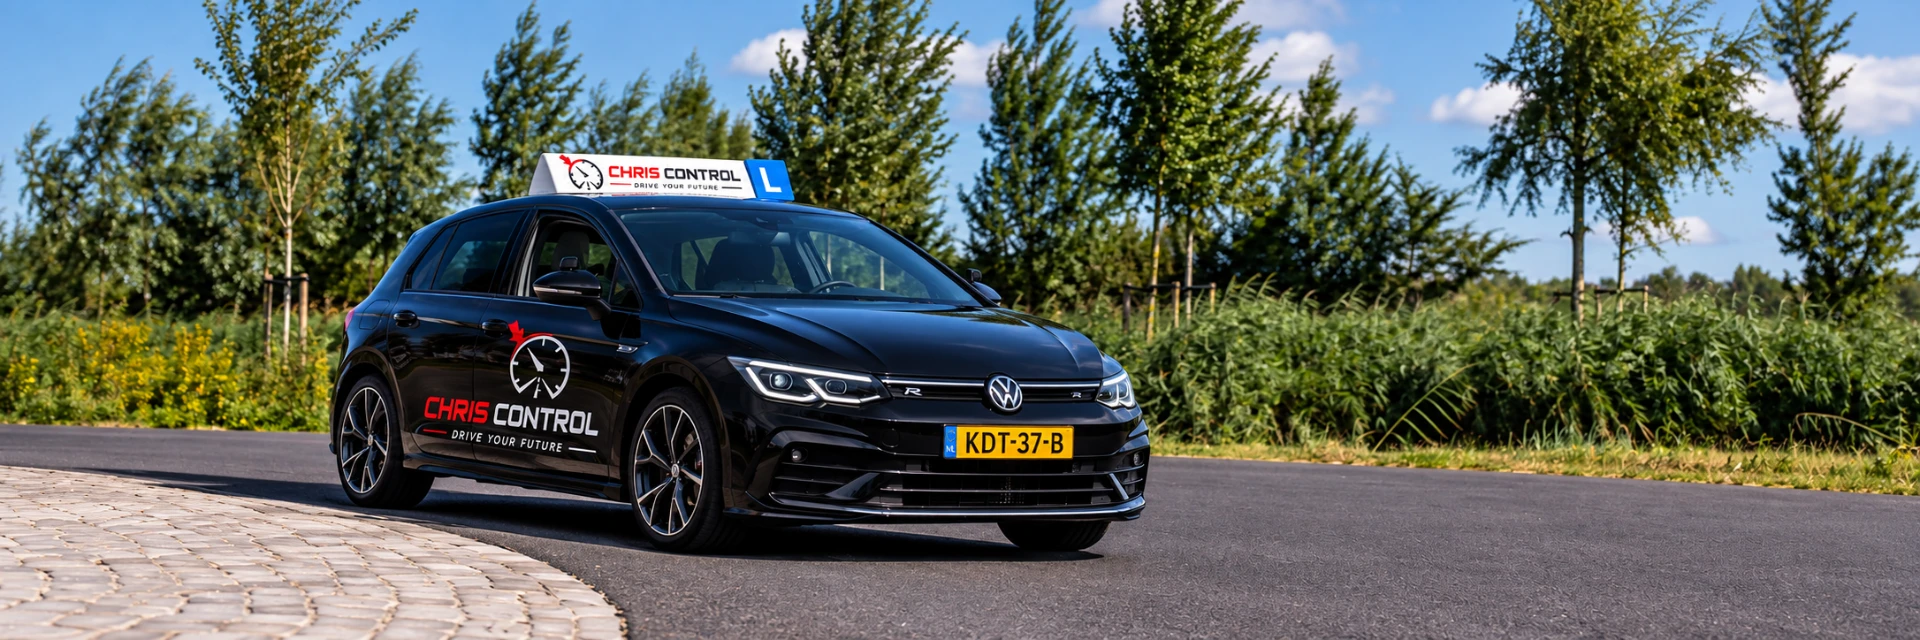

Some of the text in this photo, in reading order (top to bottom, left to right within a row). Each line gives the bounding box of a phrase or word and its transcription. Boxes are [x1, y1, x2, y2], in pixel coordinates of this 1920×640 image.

[608, 165, 741, 183] CHRIS CONTROL
[759, 167, 782, 193] L
[634, 182, 659, 190] DRIVE
[423, 396, 599, 437] CHRIS CONTROL
[451, 429, 563, 453] DRIVE YOUR FUTURE
[965, 431, 1064, 454] KDT-37-B
